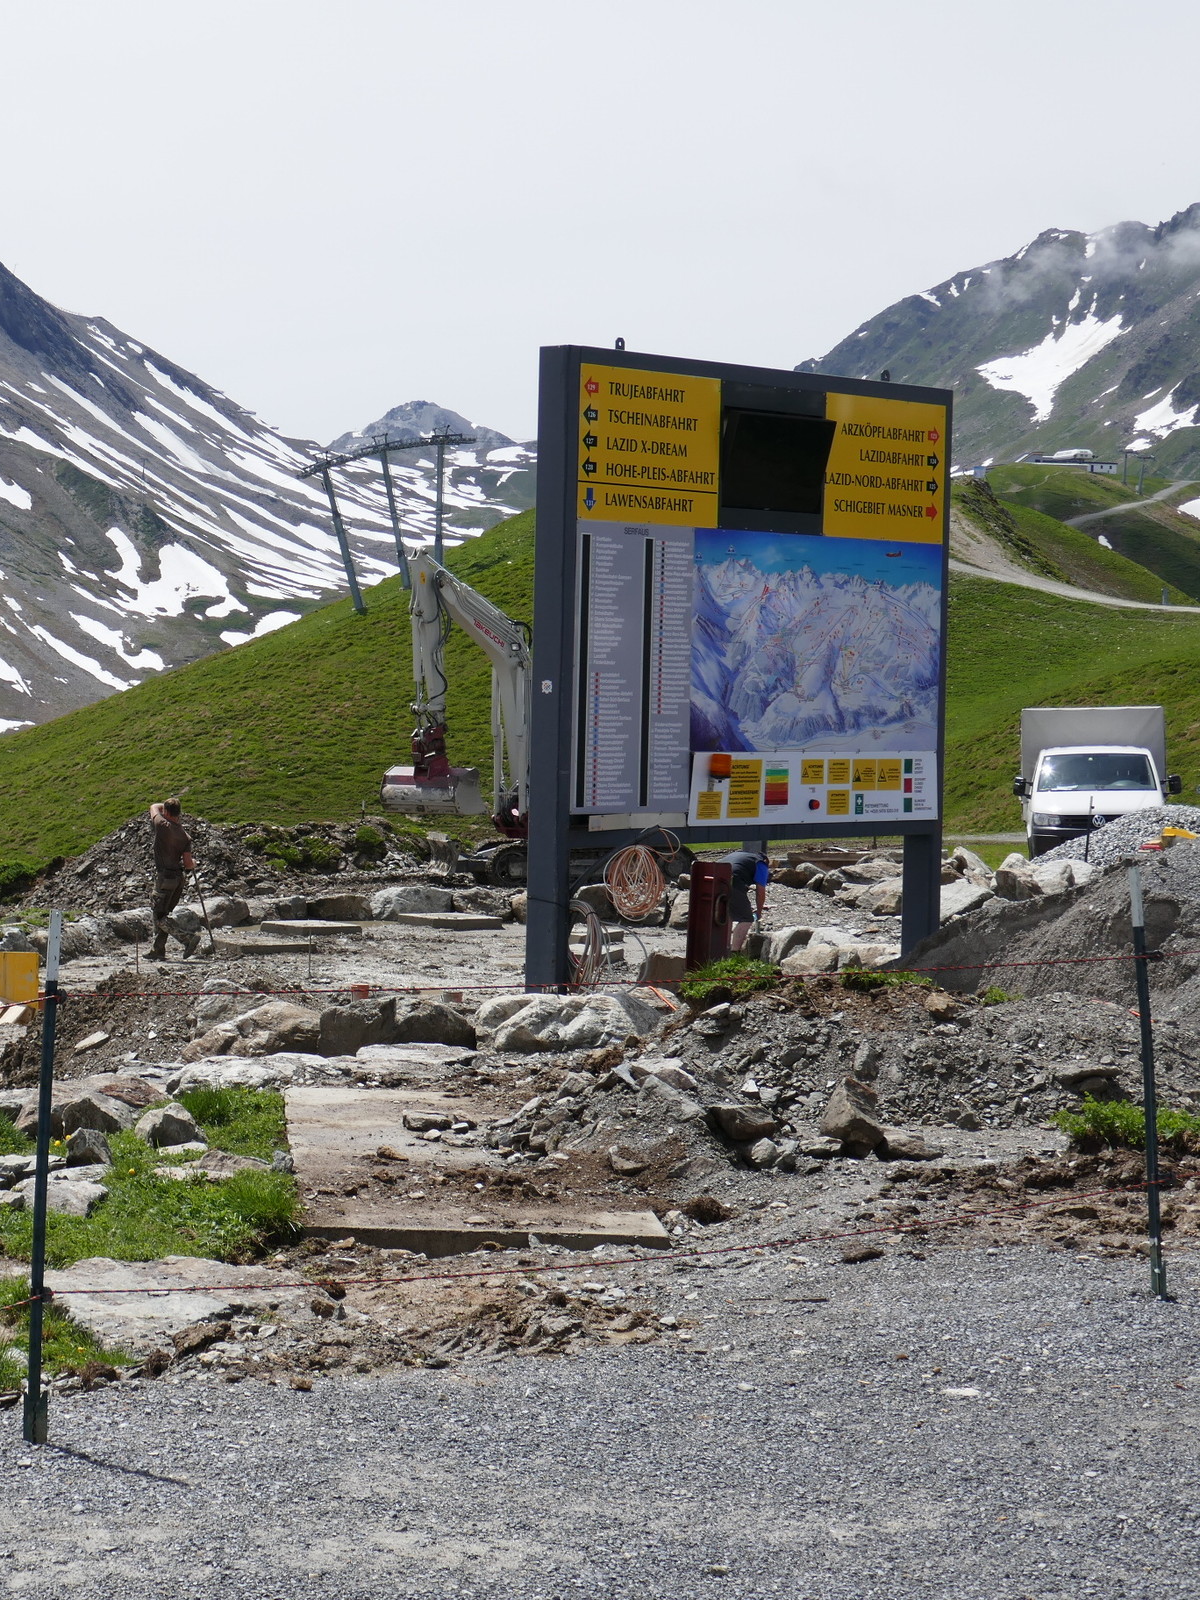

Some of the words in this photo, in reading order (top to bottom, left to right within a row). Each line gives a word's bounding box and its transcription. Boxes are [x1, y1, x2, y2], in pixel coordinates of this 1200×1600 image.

[608, 381, 685, 403] TRUJEABFAHRT
[608, 409, 698, 431] TSCHEINABFAHRT
[841, 422, 925, 443] ARZKÖPFLABFAHRT
[606, 436, 638, 453] LAZID
[640, 440, 687, 458] X-DREAM
[860, 449, 925, 467] LAZIDABFAHRT
[605, 462, 715, 486] HOHE-PLEIS-ABFAHRT
[824, 472, 924, 492] LAZID-NORD-ABFAHRT
[605, 492, 694, 512] LAWENSABFAHRT
[834, 499, 885, 515] SCHIGEBIET
[887, 503, 923, 518] MASNER
[623, 527, 650, 536] SERFAUS
